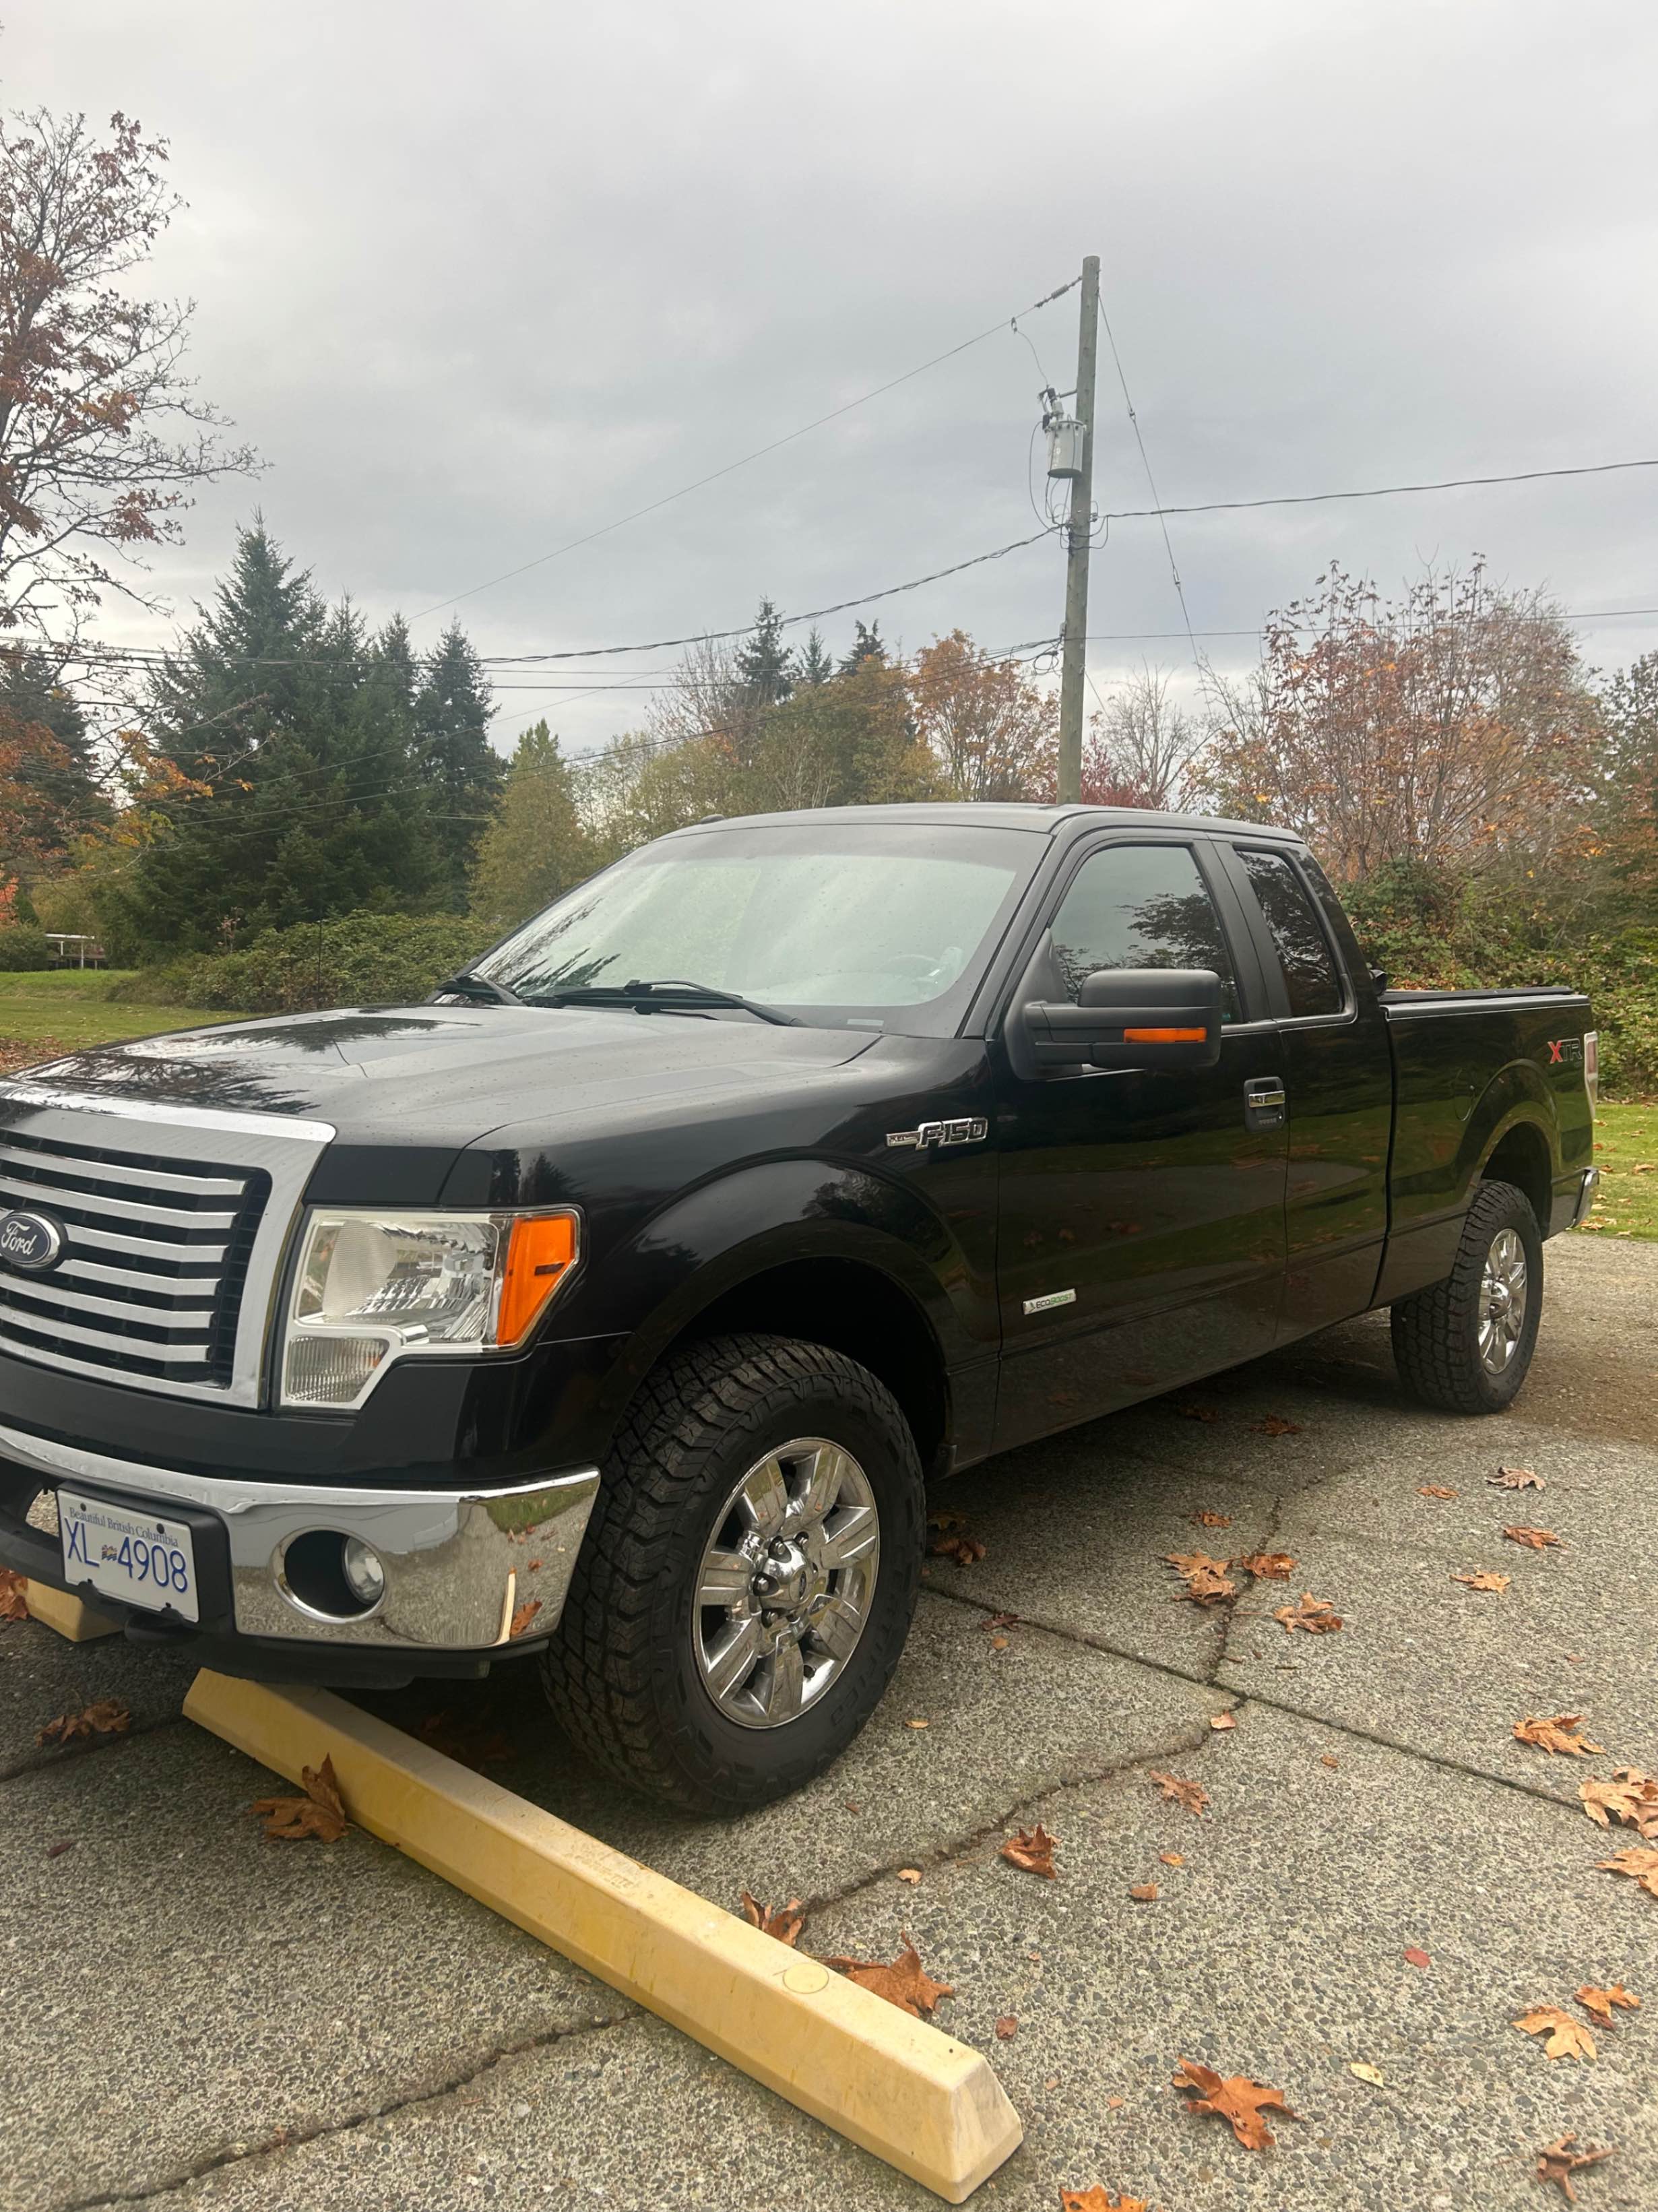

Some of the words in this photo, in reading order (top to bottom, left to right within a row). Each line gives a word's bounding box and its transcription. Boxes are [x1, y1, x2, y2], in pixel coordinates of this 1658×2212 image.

[1548, 1038, 1583, 1064] XTR
[1, 1221, 37, 1255] Ford
[69, 1507, 105, 1527] Beautiful
[108, 1518, 135, 1535] British
[136, 1525, 178, 1546] Columbia
[65, 1517, 100, 1568] XL
[118, 1536, 187, 1593] 4908
